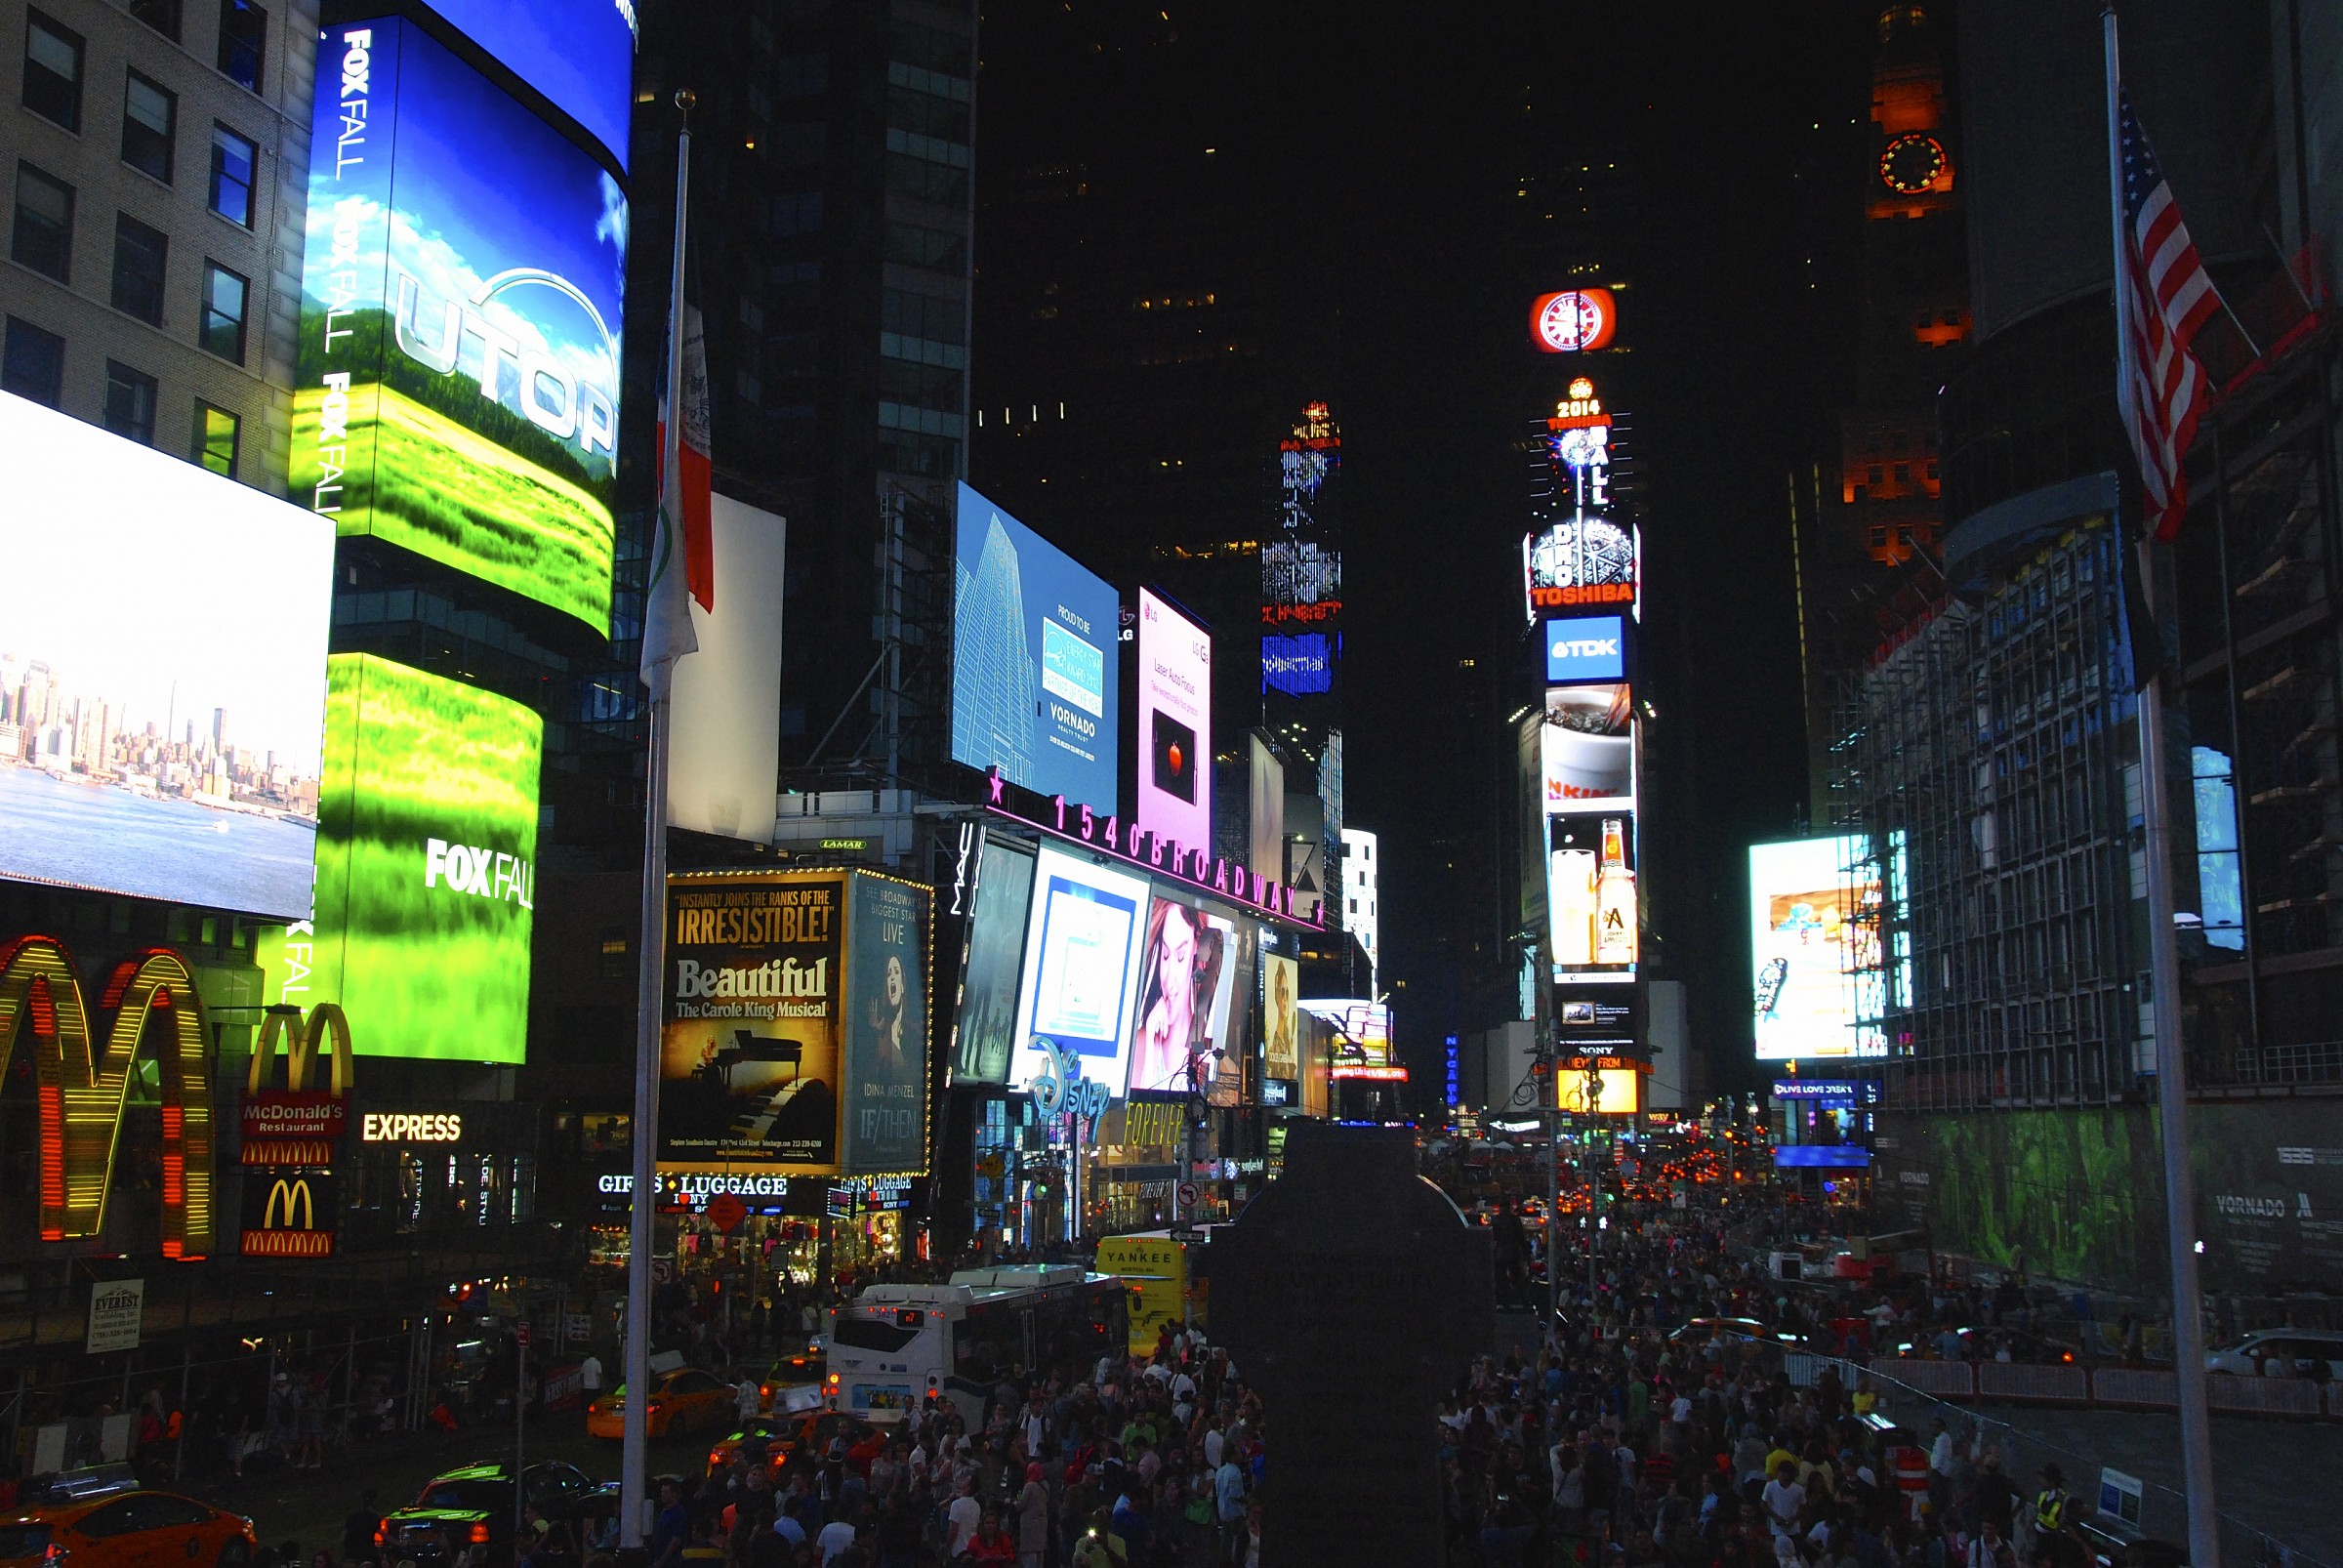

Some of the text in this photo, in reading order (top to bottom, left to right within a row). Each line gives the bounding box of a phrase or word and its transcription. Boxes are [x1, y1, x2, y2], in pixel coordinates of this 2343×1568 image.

[336, 28, 372, 182] FOX FALL
[324, 199, 360, 353] FOX FALL
[319, 371, 351, 443] FOX
[1557, 399, 1601, 418] 2014
[1546, 413, 1611, 431] TOSHIBA
[1589, 425, 1610, 506] BALL
[1532, 584, 1633, 606] TOSHIBA
[1057, 603, 1090, 636] PROUD TO BE
[1117, 629, 1133, 641] LG
[1565, 638, 1619, 658] TDK
[1154, 657, 1196, 695] Laser Auto Focus
[1049, 701, 1095, 738] VORNADO
[1057, 723, 1089, 744] REALTY TRUST
[822, 840, 863, 849] LAMAR
[1055, 794, 1295, 916] 1540 BROADWAY
[425, 838, 533, 910] FOX FALL
[723, 892, 750, 908] JOINS
[751, 891, 768, 907] THE
[768, 890, 800, 906] RANKS
[801, 890, 813, 906] OF
[813, 889, 830, 906] THE
[866, 886, 878, 899] SEE
[871, 905, 917, 923] BIGGEST STAR
[883, 921, 904, 945] LIVE
[676, 956, 828, 998] Beautiful
[676, 1001, 826, 1021] The Carole King Musical
[1597, 1056, 1621, 1068] FROM
[864, 1083, 915, 1098] IDINA MENZEL
[244, 1103, 343, 1120] McDonald's
[259, 1122, 325, 1132] Restaurant
[363, 1114, 462, 1140] EXPRESS
[860, 1104, 917, 1144] IF/THEN
[1123, 1101, 1187, 1146] FOREVER
[597, 1175, 788, 1195] GIFS LUGGAGE
[873, 1175, 912, 1191] LUGGAGE
[673, 1193, 710, 1205] I NY
[883, 1201, 898, 1210] SONY
[2215, 1194, 2285, 1217] VORNADO
[1107, 1252, 1172, 1263] YANKEE
[95, 1295, 140, 1310] EVEREST
